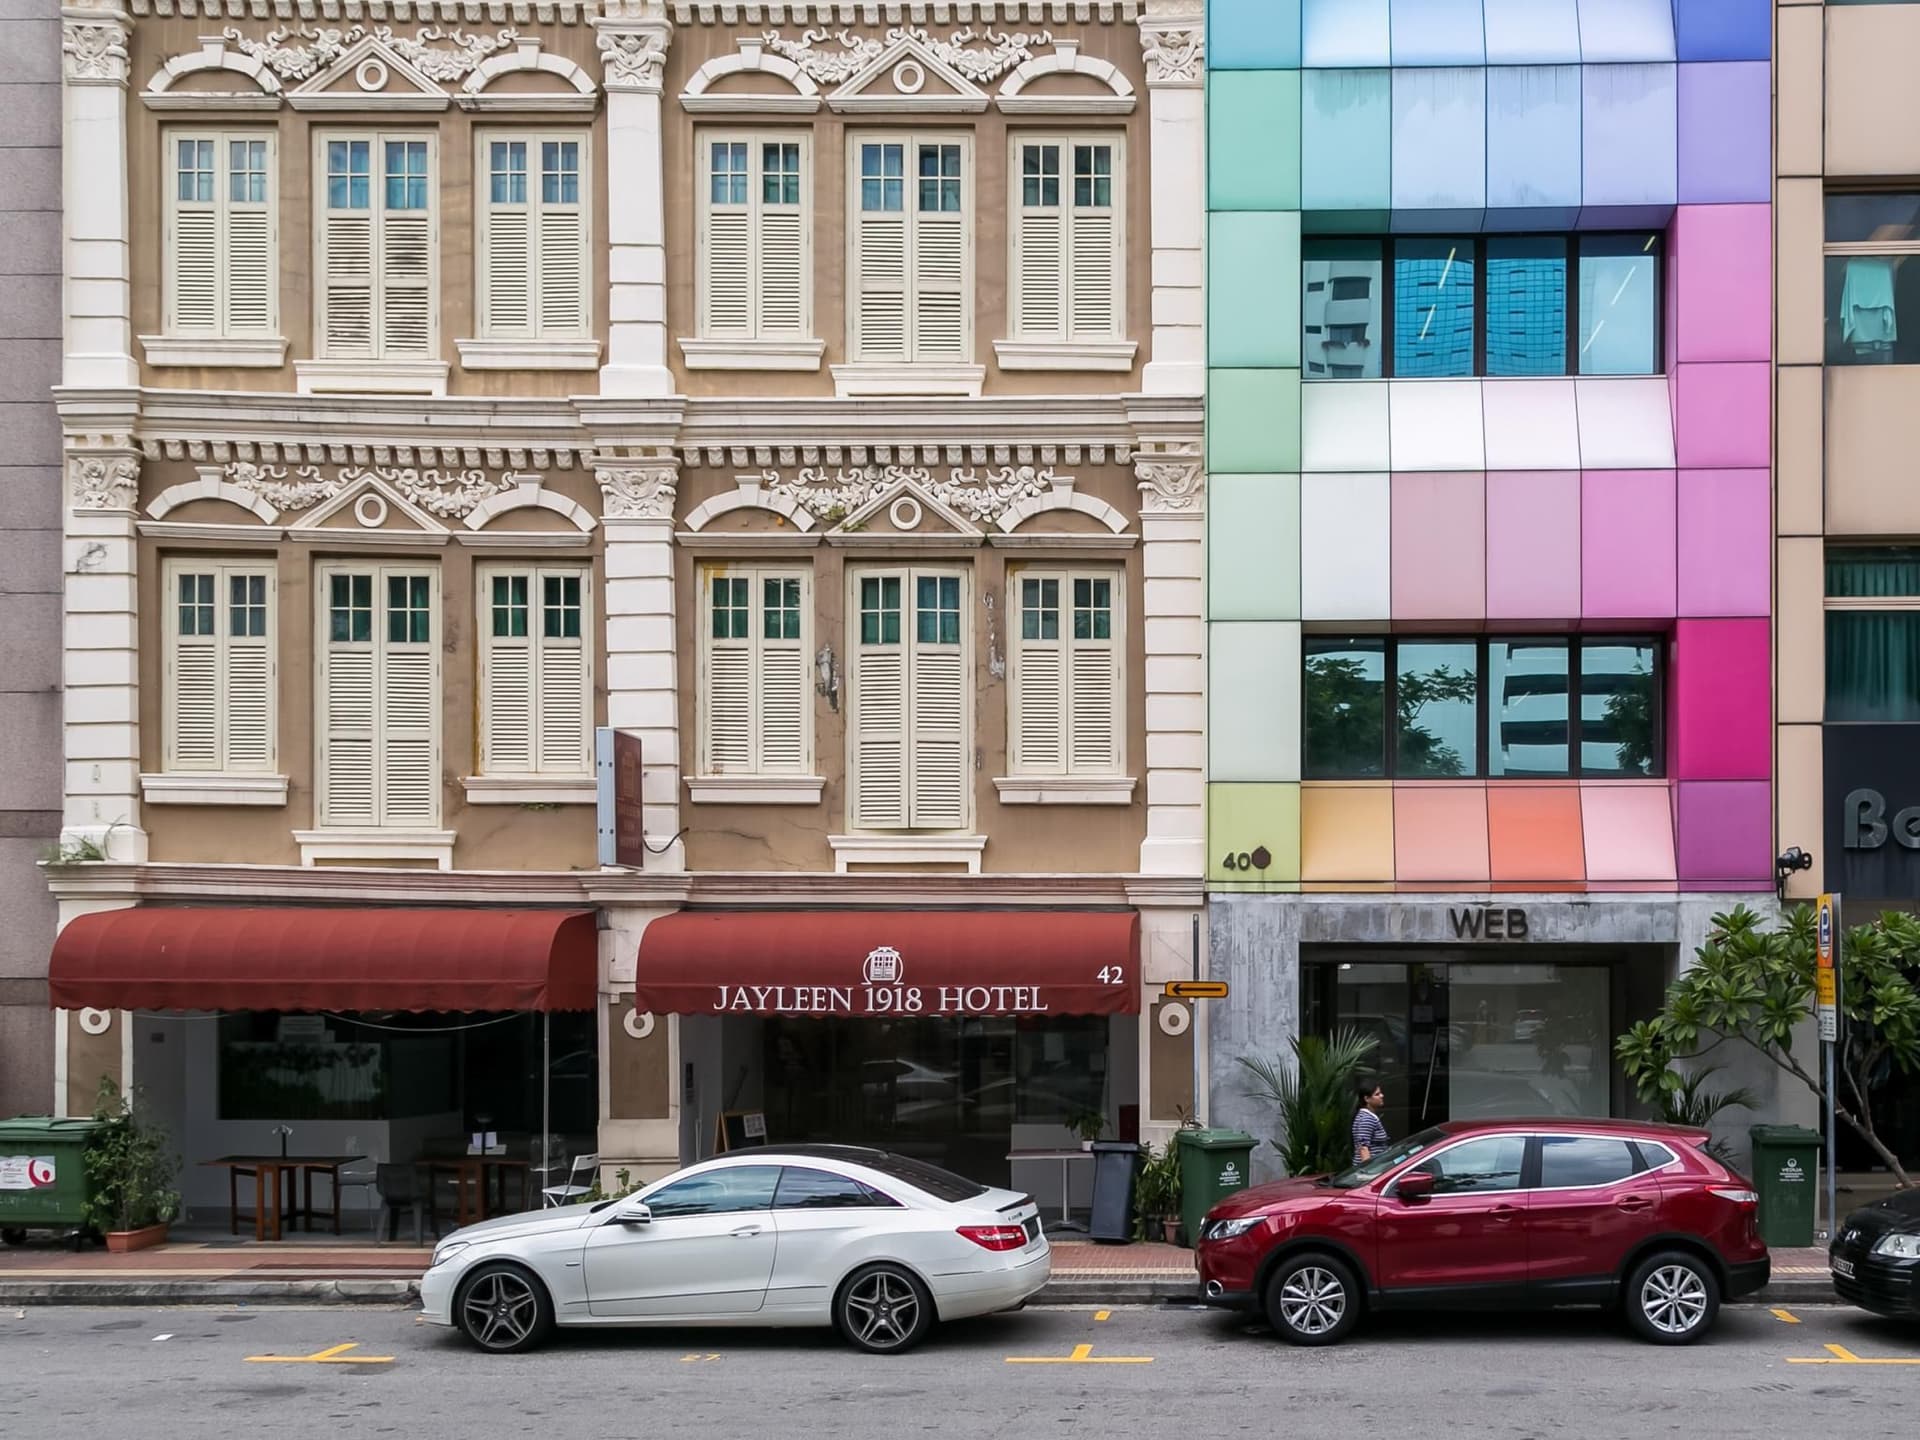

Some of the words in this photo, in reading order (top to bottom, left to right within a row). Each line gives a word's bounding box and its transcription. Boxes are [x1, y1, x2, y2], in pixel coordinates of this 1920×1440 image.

[1223, 852, 1250, 871] 40
[1449, 908, 1528, 938] WEB
[1097, 965, 1124, 984] 42
[713, 986, 853, 1012] JAYLEEN
[864, 987, 923, 1012] 1918
[938, 986, 1049, 1011] HOTEL
